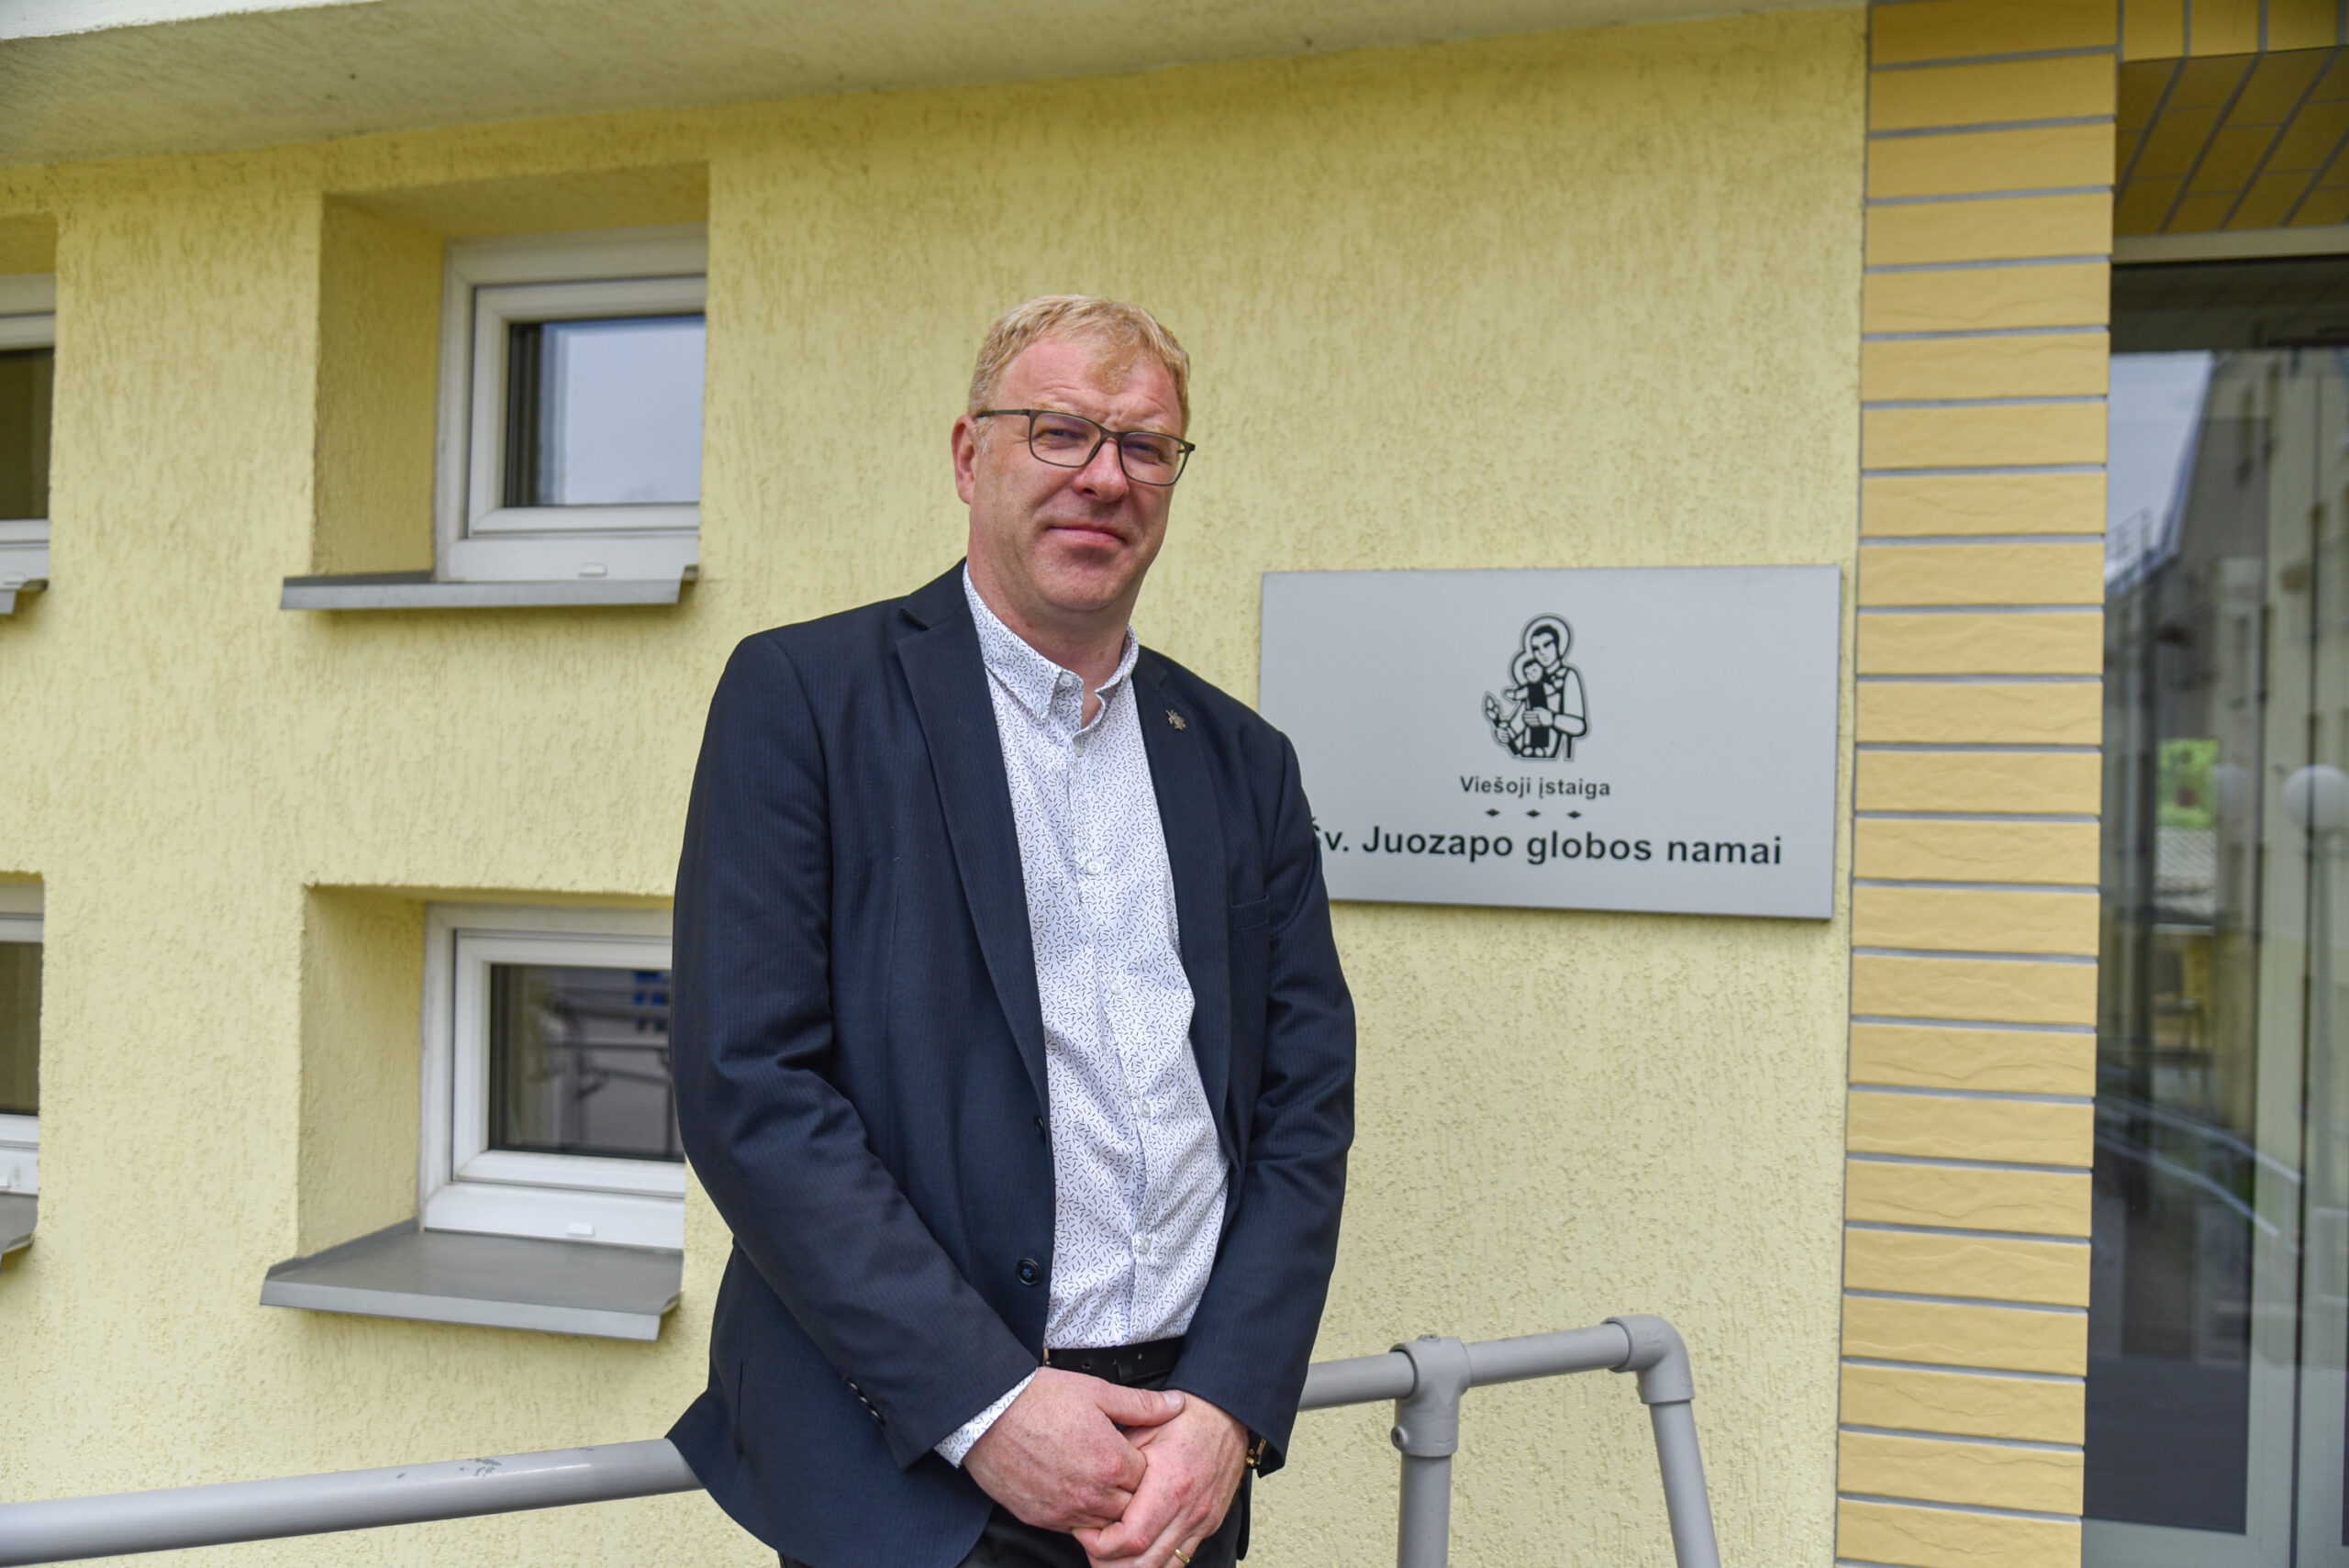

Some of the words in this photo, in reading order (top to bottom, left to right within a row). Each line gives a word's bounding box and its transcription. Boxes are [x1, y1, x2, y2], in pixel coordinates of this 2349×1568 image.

[1460, 774, 1531, 799] Viešoji
[1538, 777, 1611, 801] įstaiga
[1362, 825, 1514, 863] Juozapo
[1526, 829, 1653, 866] globos
[1666, 835, 1783, 865] namai
